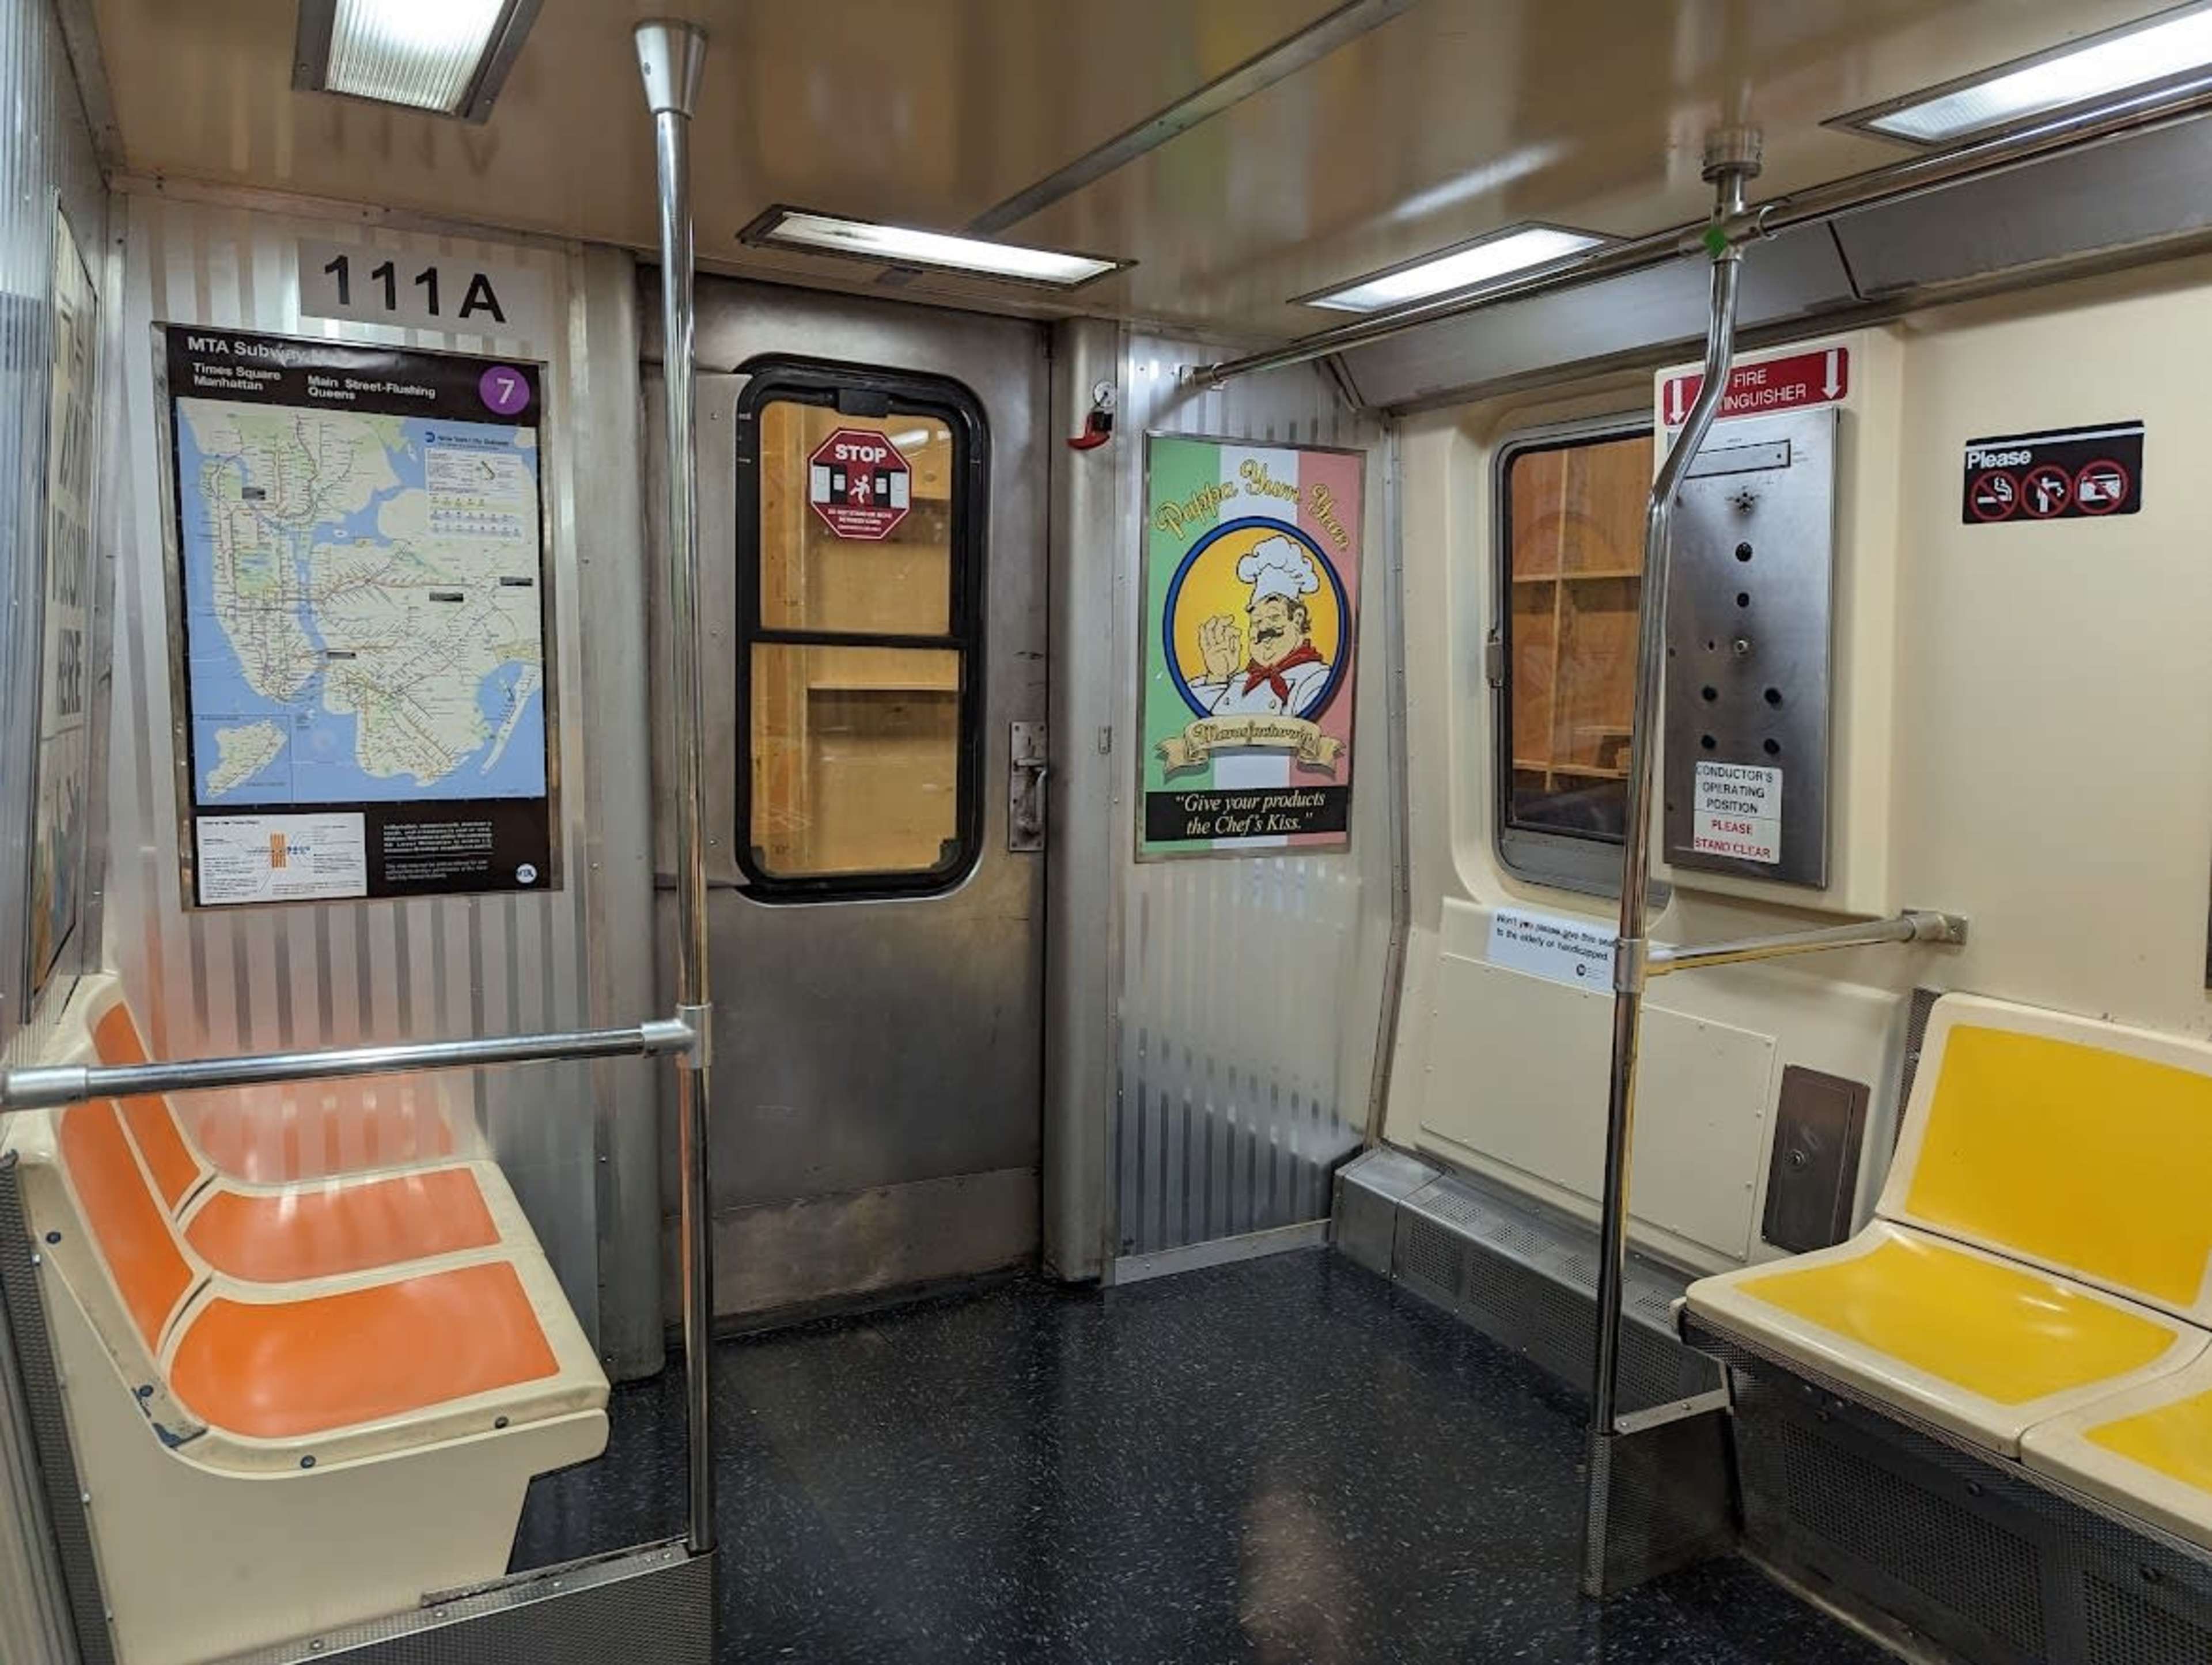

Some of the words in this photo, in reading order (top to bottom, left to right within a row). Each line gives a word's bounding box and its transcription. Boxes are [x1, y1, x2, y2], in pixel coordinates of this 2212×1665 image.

[324, 255, 506, 323] 111A
[187, 336, 229, 354] MTA
[192, 362, 233, 375] Times
[236, 366, 282, 381] Square
[1734, 368, 1768, 388] FIRE
[194, 376, 264, 390] Manhattan
[308, 374, 339, 388] Main
[345, 378, 436, 399] Street-Flushing
[496, 377, 515, 404] 7
[308, 386, 356, 400] Queens
[835, 443, 887, 464] STOP
[1967, 450, 2032, 469] Please
[1703, 782, 1765, 798] OPERATING
[1222, 797, 1261, 815] your
[1261, 790, 1326, 813] products
[1706, 798, 1758, 814] POSITION
[1186, 817, 1211, 835] the
[1711, 820, 1753, 835] PLEASE
[1695, 837, 1730, 852] STAND
[1733, 843, 1770, 859] CLEAR
[1497, 927, 1504, 937] to
[1506, 929, 1517, 940] the
[1520, 934, 1545, 947] elderly
